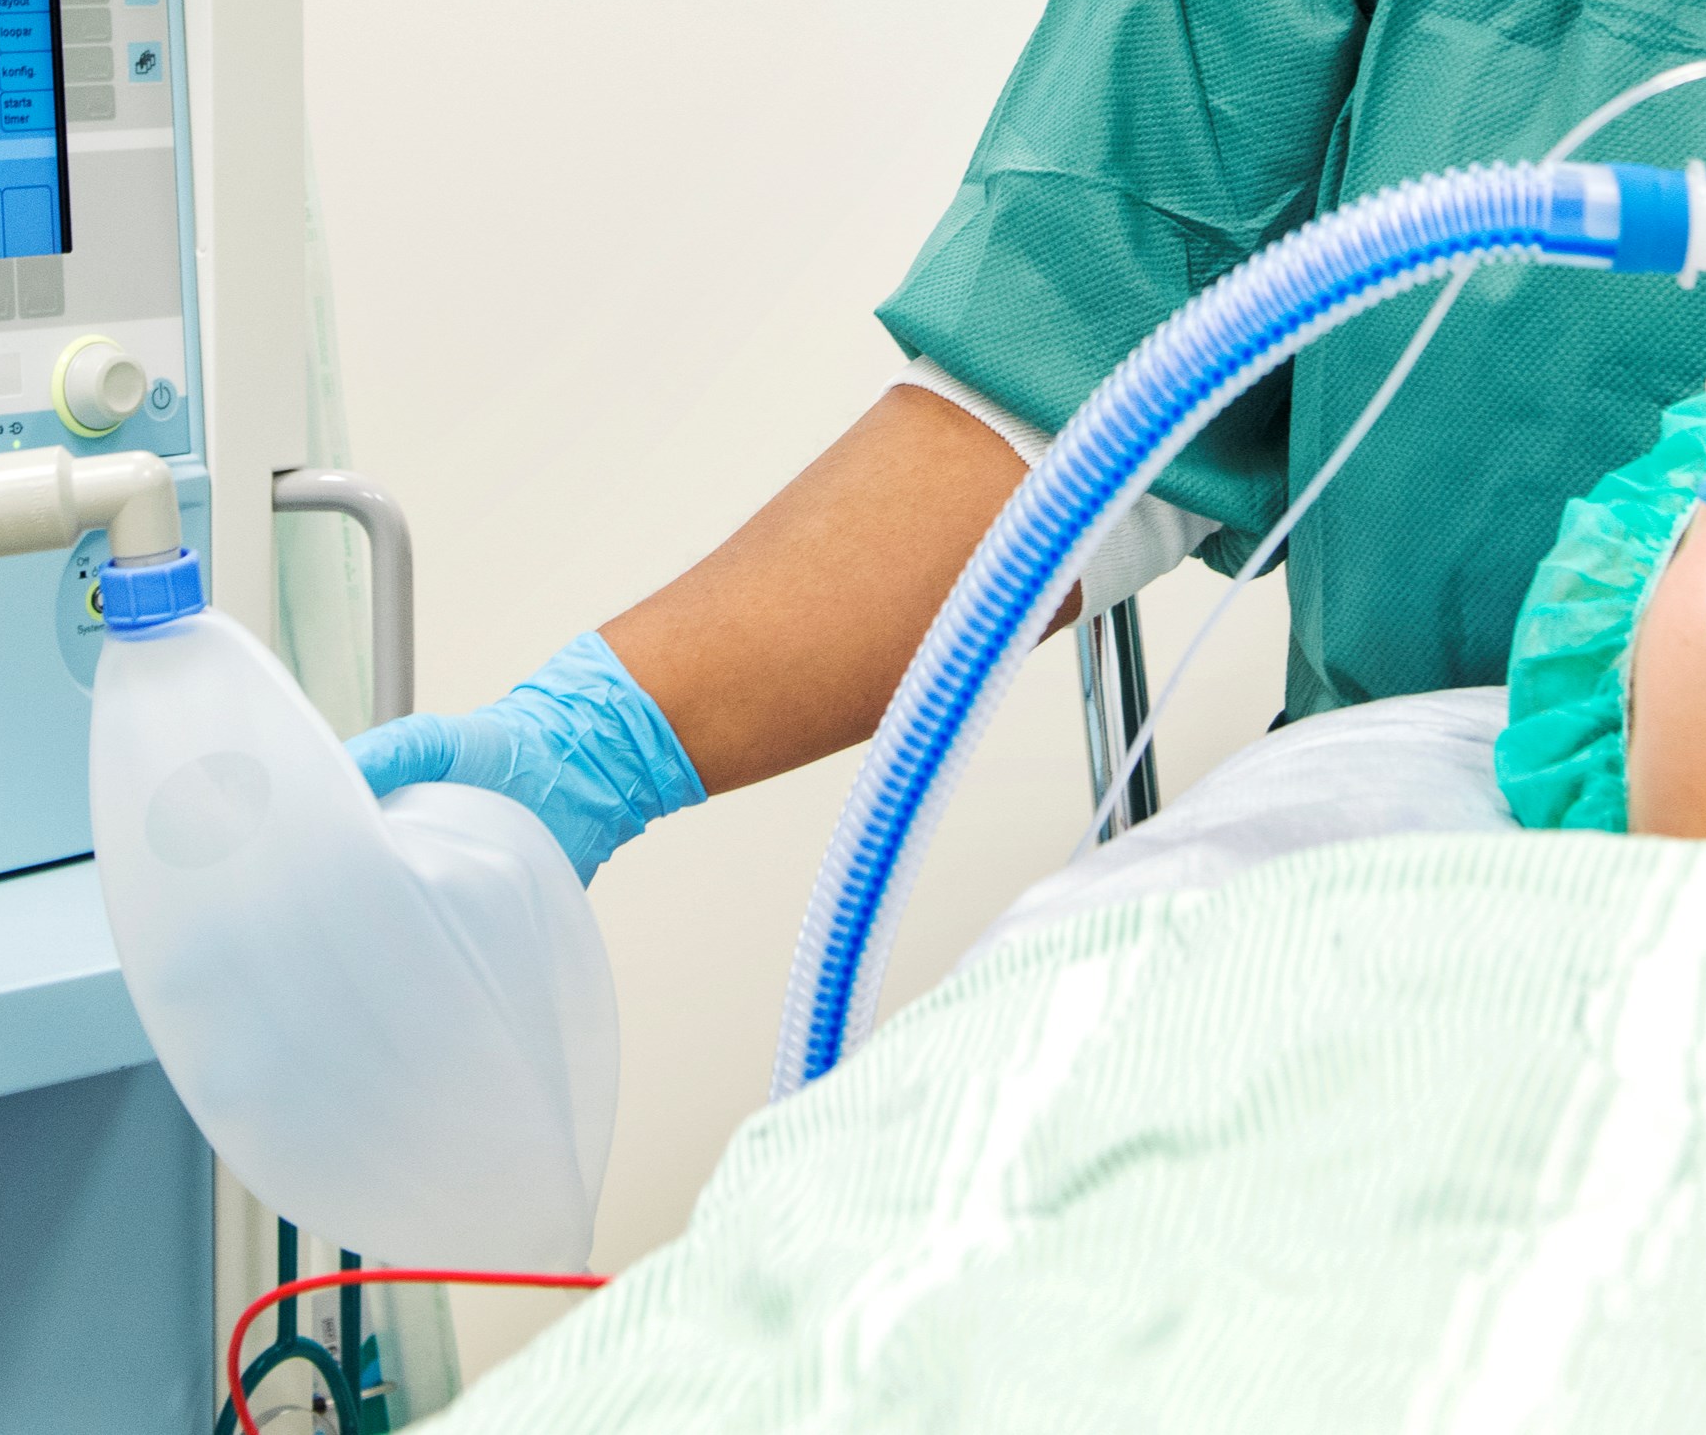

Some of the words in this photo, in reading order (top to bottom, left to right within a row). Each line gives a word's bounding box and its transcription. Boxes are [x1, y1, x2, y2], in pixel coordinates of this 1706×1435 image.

[0, 26, 32, 38] loopar
[3, 97, 32, 108] starta
[4, 114, 29, 125] timer
